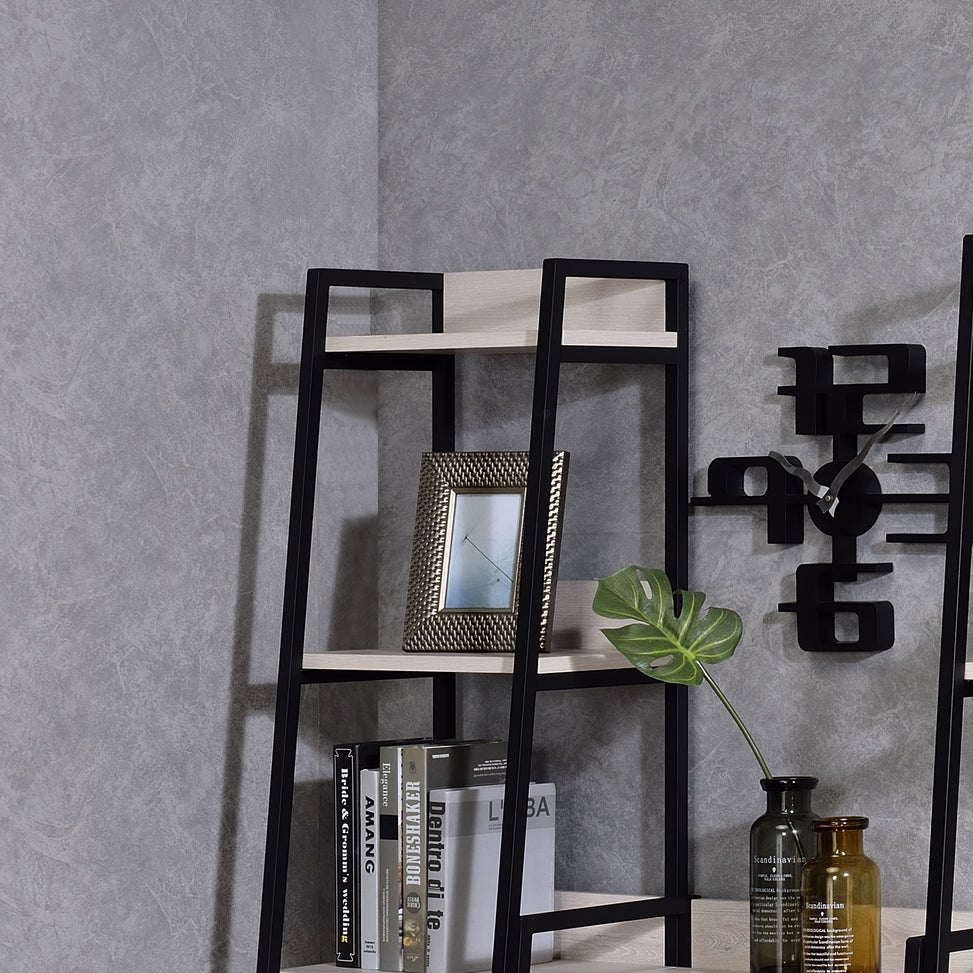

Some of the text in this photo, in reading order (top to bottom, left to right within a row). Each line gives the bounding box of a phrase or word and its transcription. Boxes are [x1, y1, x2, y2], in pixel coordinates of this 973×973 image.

[778, 562, 895, 652] 6
[381, 762, 391, 807] Elegance
[340, 768, 350, 943] Bride & Gromm's wedding
[366, 796, 374, 874] AMANG
[406, 781, 420, 886] BONESHAKER
[427, 802, 446, 930] Dentro di te
[754, 855, 806, 864] Scandinavian
